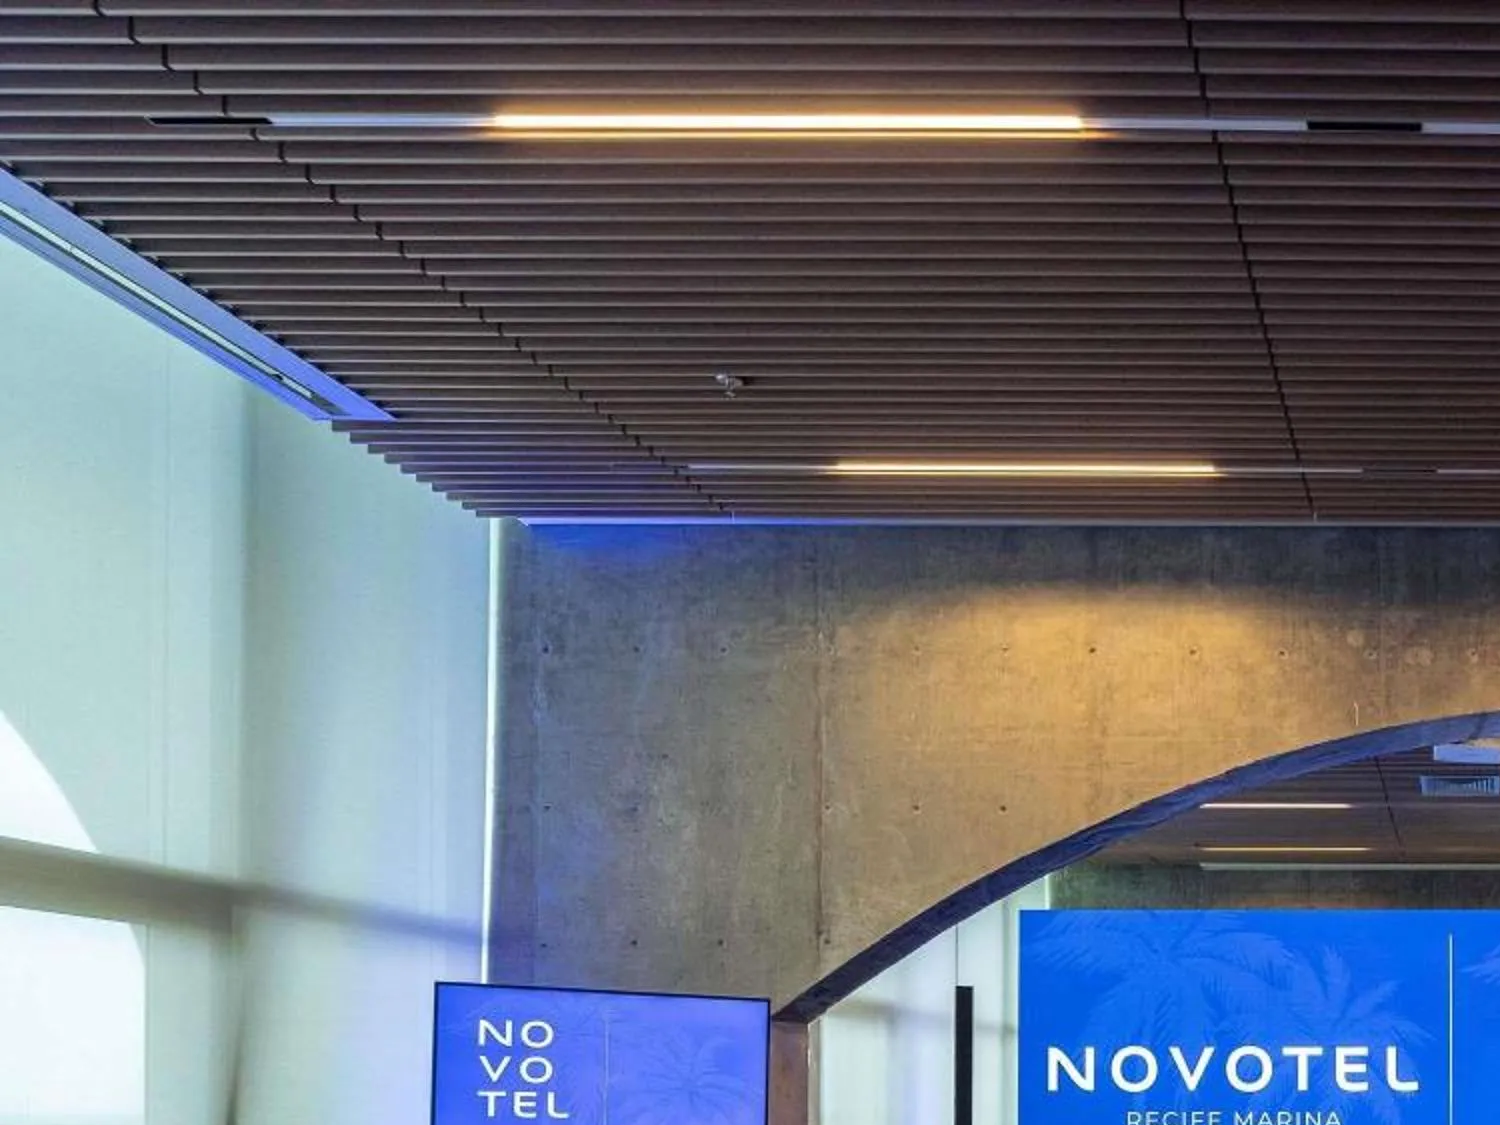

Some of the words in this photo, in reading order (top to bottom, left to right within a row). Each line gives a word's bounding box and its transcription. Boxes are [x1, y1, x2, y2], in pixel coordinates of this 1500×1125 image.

[478, 1019, 554, 1048] NO
[479, 1055, 553, 1084] VO
[1046, 1044, 1420, 1093] NOVOTEL
[476, 1090, 570, 1119] TEL
